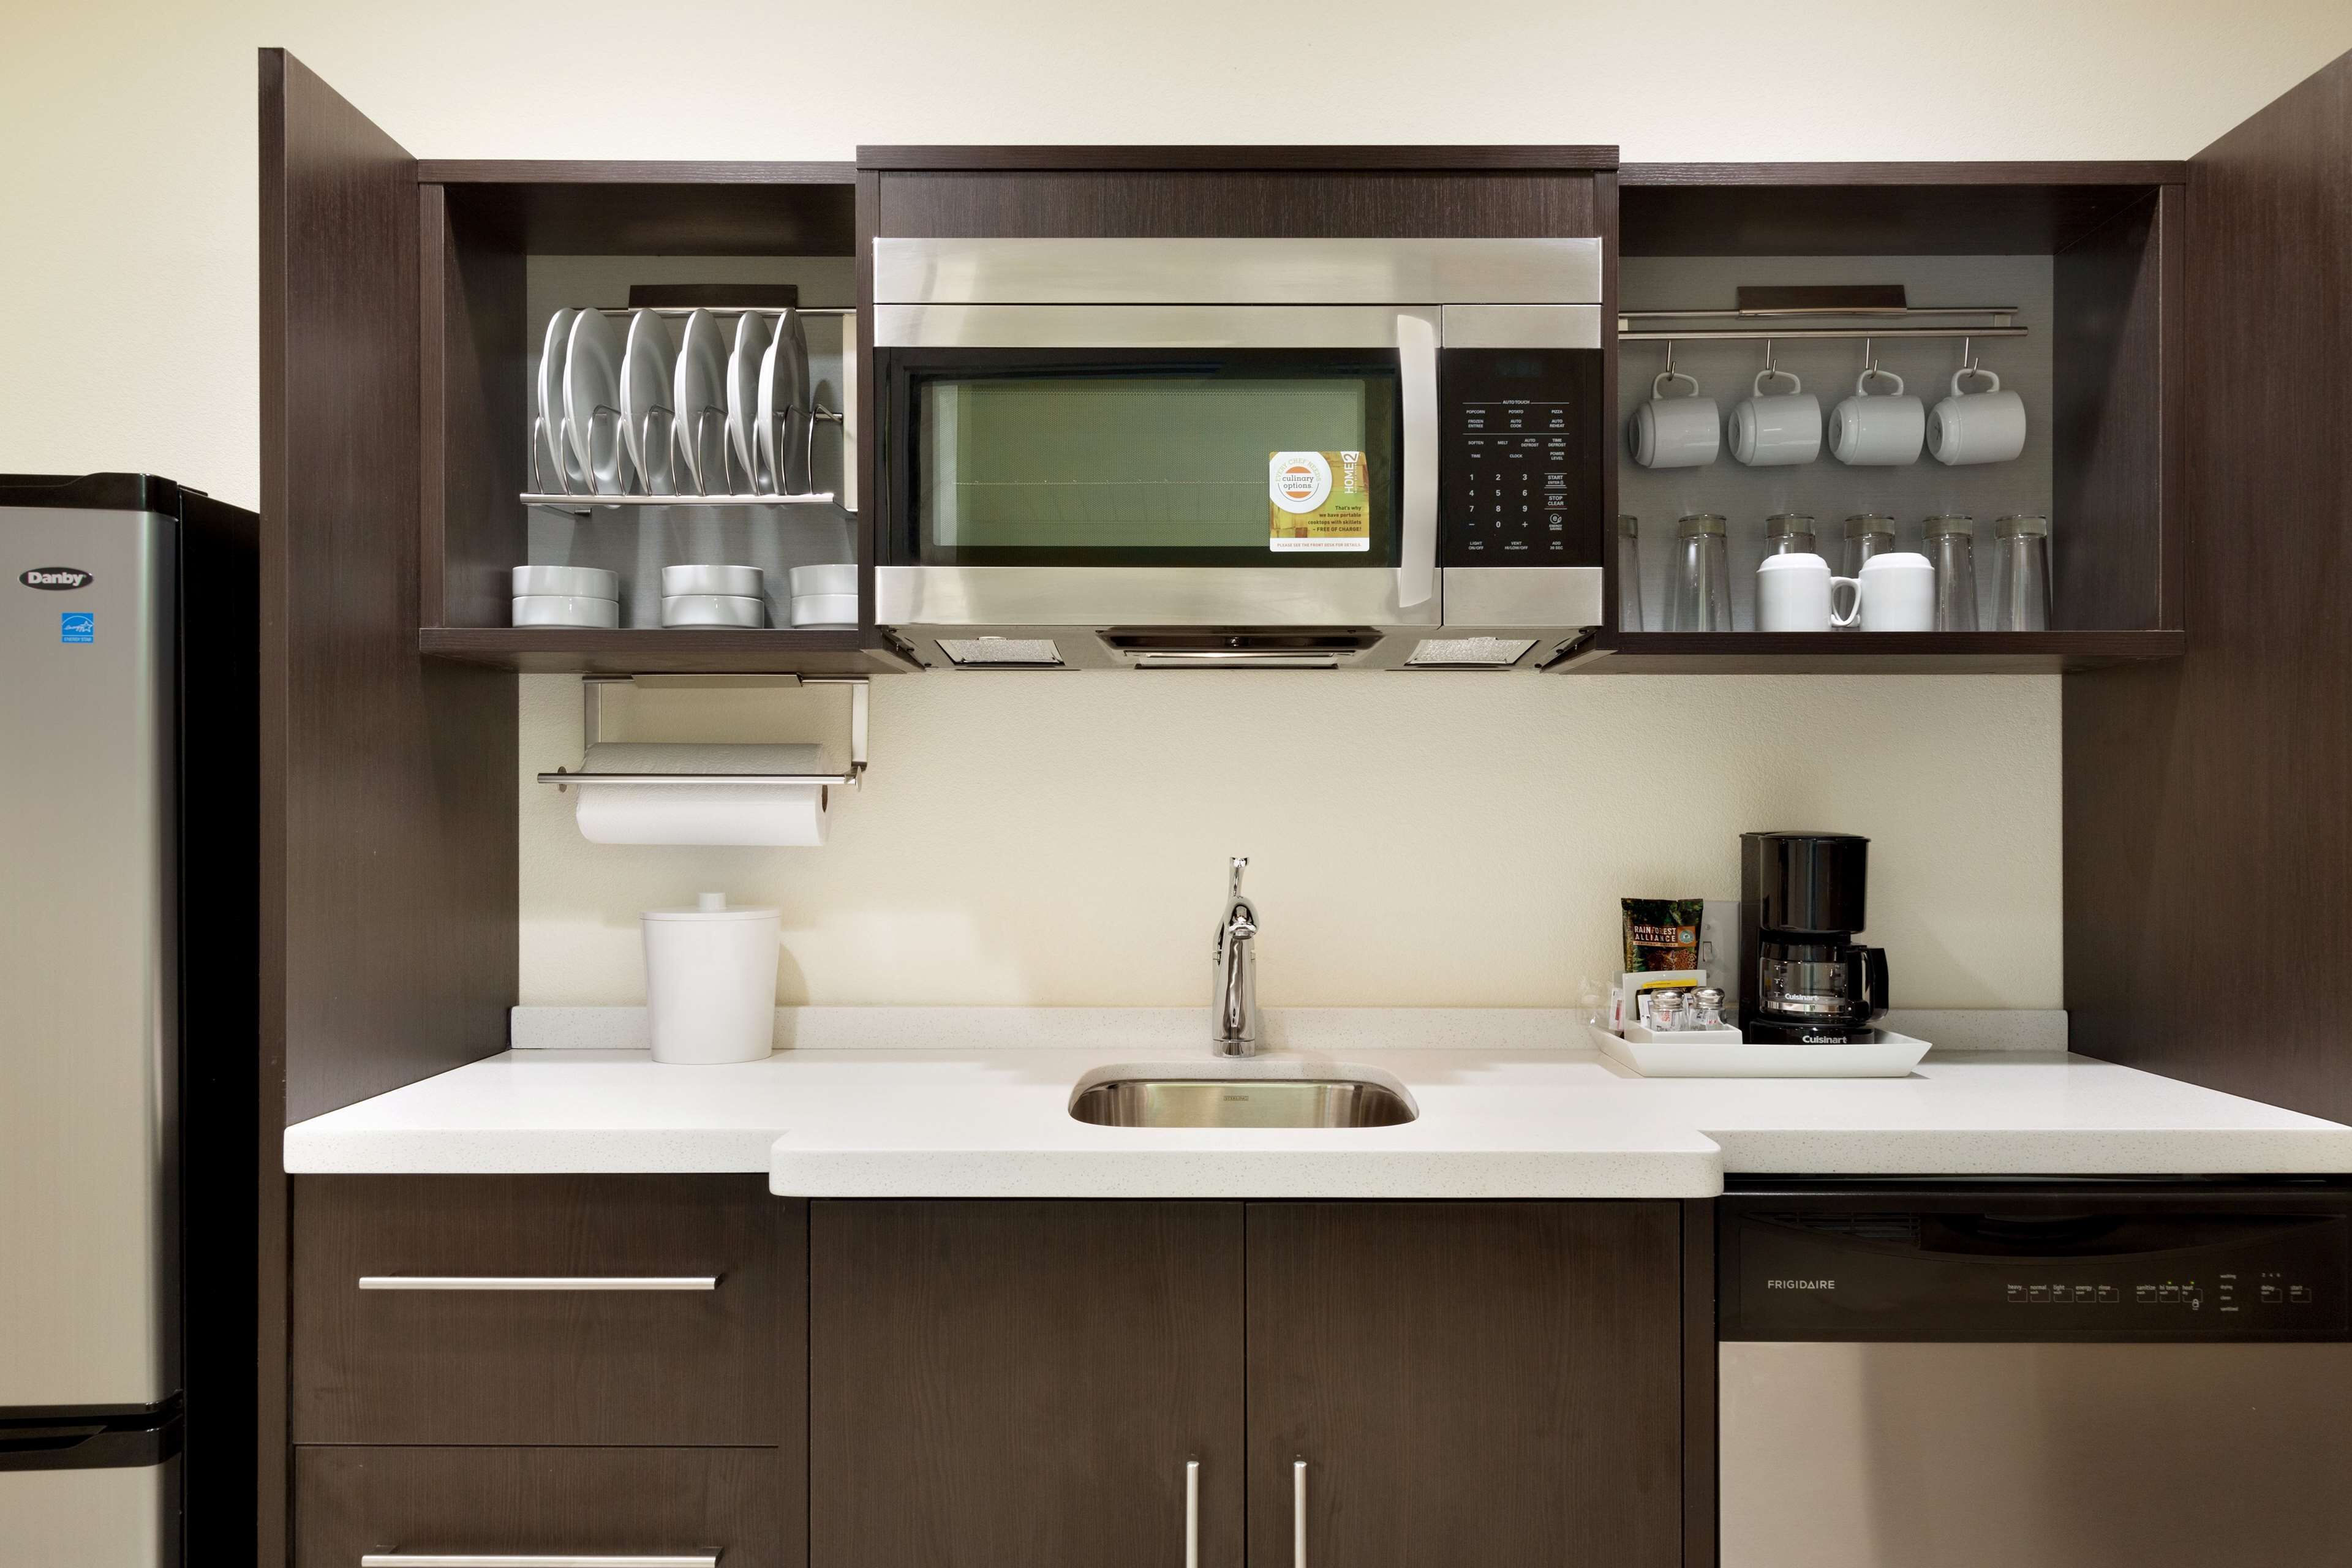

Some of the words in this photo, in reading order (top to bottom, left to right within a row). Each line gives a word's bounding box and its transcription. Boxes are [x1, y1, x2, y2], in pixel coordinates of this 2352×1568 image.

[28, 571, 85, 586] Danby
[1634, 925, 1676, 935] RAINFOREST
[1803, 1035, 1847, 1044] Cuisinart
[1768, 1280, 1835, 1289] FRIGIDAIRE
